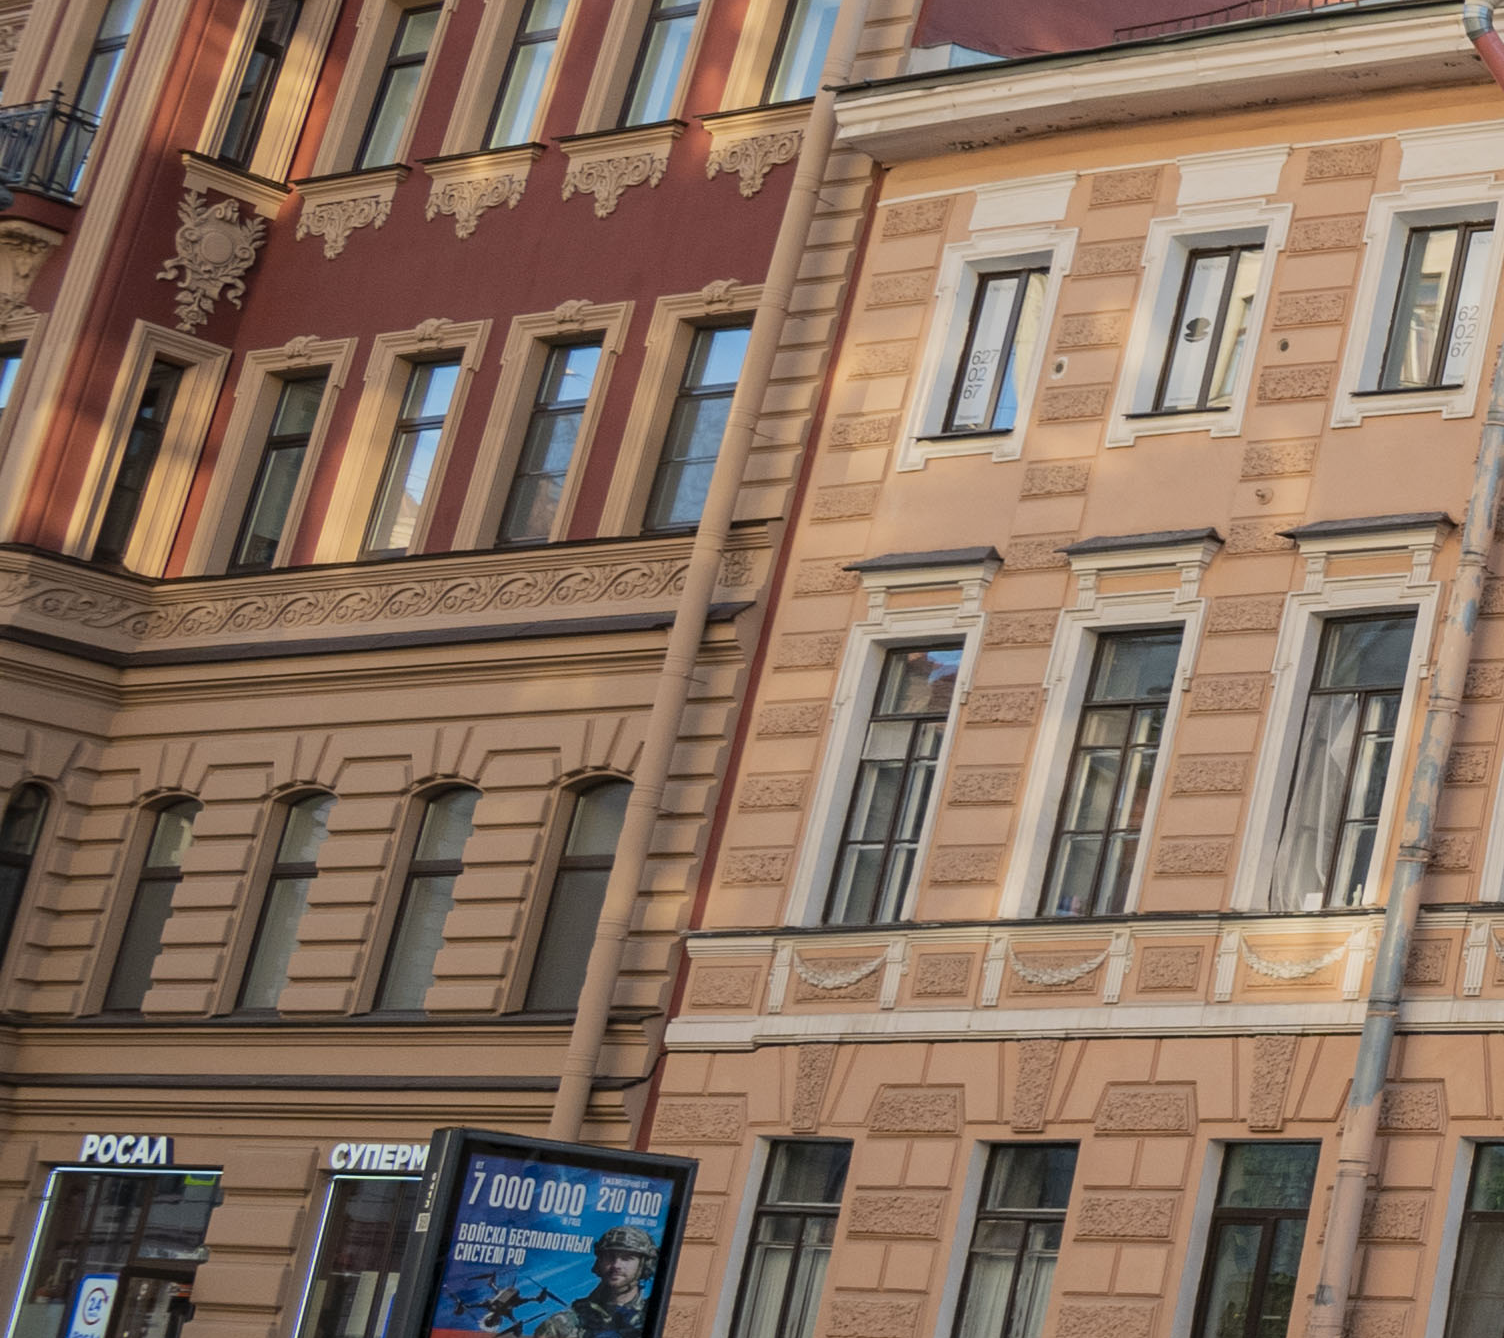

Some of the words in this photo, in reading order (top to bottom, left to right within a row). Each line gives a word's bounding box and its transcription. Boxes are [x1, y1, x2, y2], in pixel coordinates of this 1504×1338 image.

[80, 1134, 168, 1165] РОСАЛ
[330, 1143, 430, 1171] СУПЕРМ
[468, 1172, 487, 1205] 7
[489, 1173, 536, 1211] 000
[539, 1180, 587, 1217] 000
[596, 1186, 627, 1213] 210
[628, 1190, 662, 1217] 000
[458, 1222, 508, 1245] ВОЙСКА
[508, 1228, 593, 1253] БЕСПИЛОТНЫХ
[454, 1243, 505, 1265] СИСТЕМ
[505, 1248, 526, 1266] РФ
